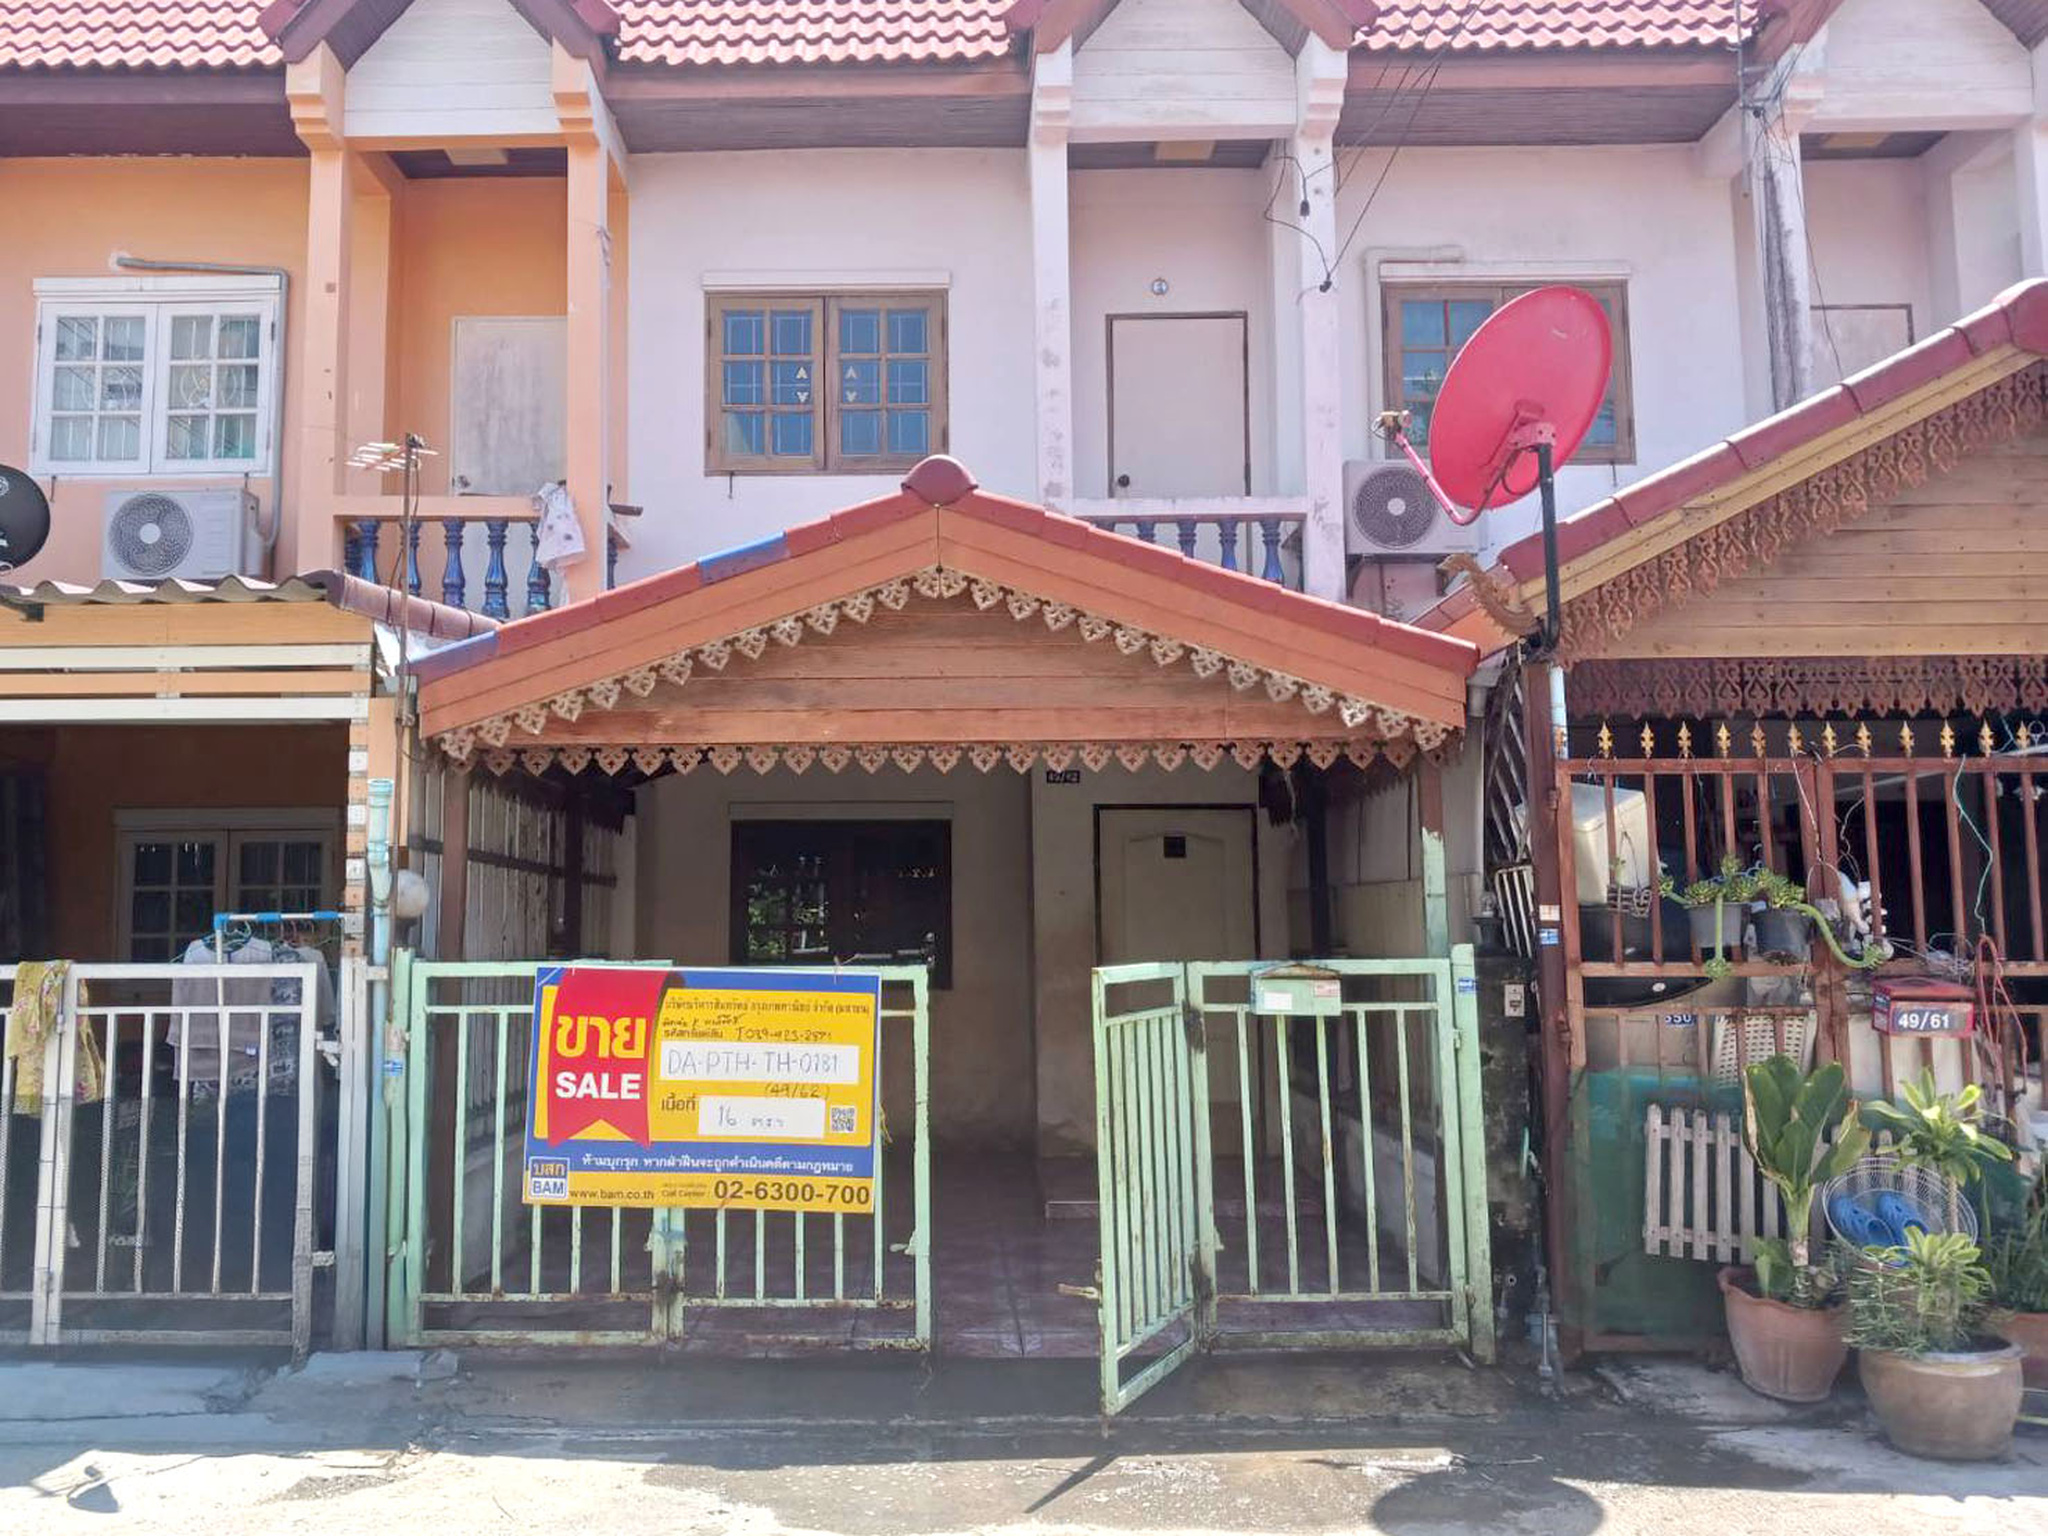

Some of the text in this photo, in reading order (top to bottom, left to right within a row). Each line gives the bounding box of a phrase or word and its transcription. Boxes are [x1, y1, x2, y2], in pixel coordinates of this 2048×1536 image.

[1898, 1011, 1950, 1030] 49/61
[556, 1015, 646, 1059] ขาย
[555, 1070, 642, 1099] SALE
[718, 1106, 738, 1127] 16
[582, 1153, 639, 1171] ห้ามบุกรุก
[533, 1180, 564, 1195] BAM
[569, 1188, 655, 1200] www.bam.co.th
[714, 1180, 870, 1205] 02-6300-700
